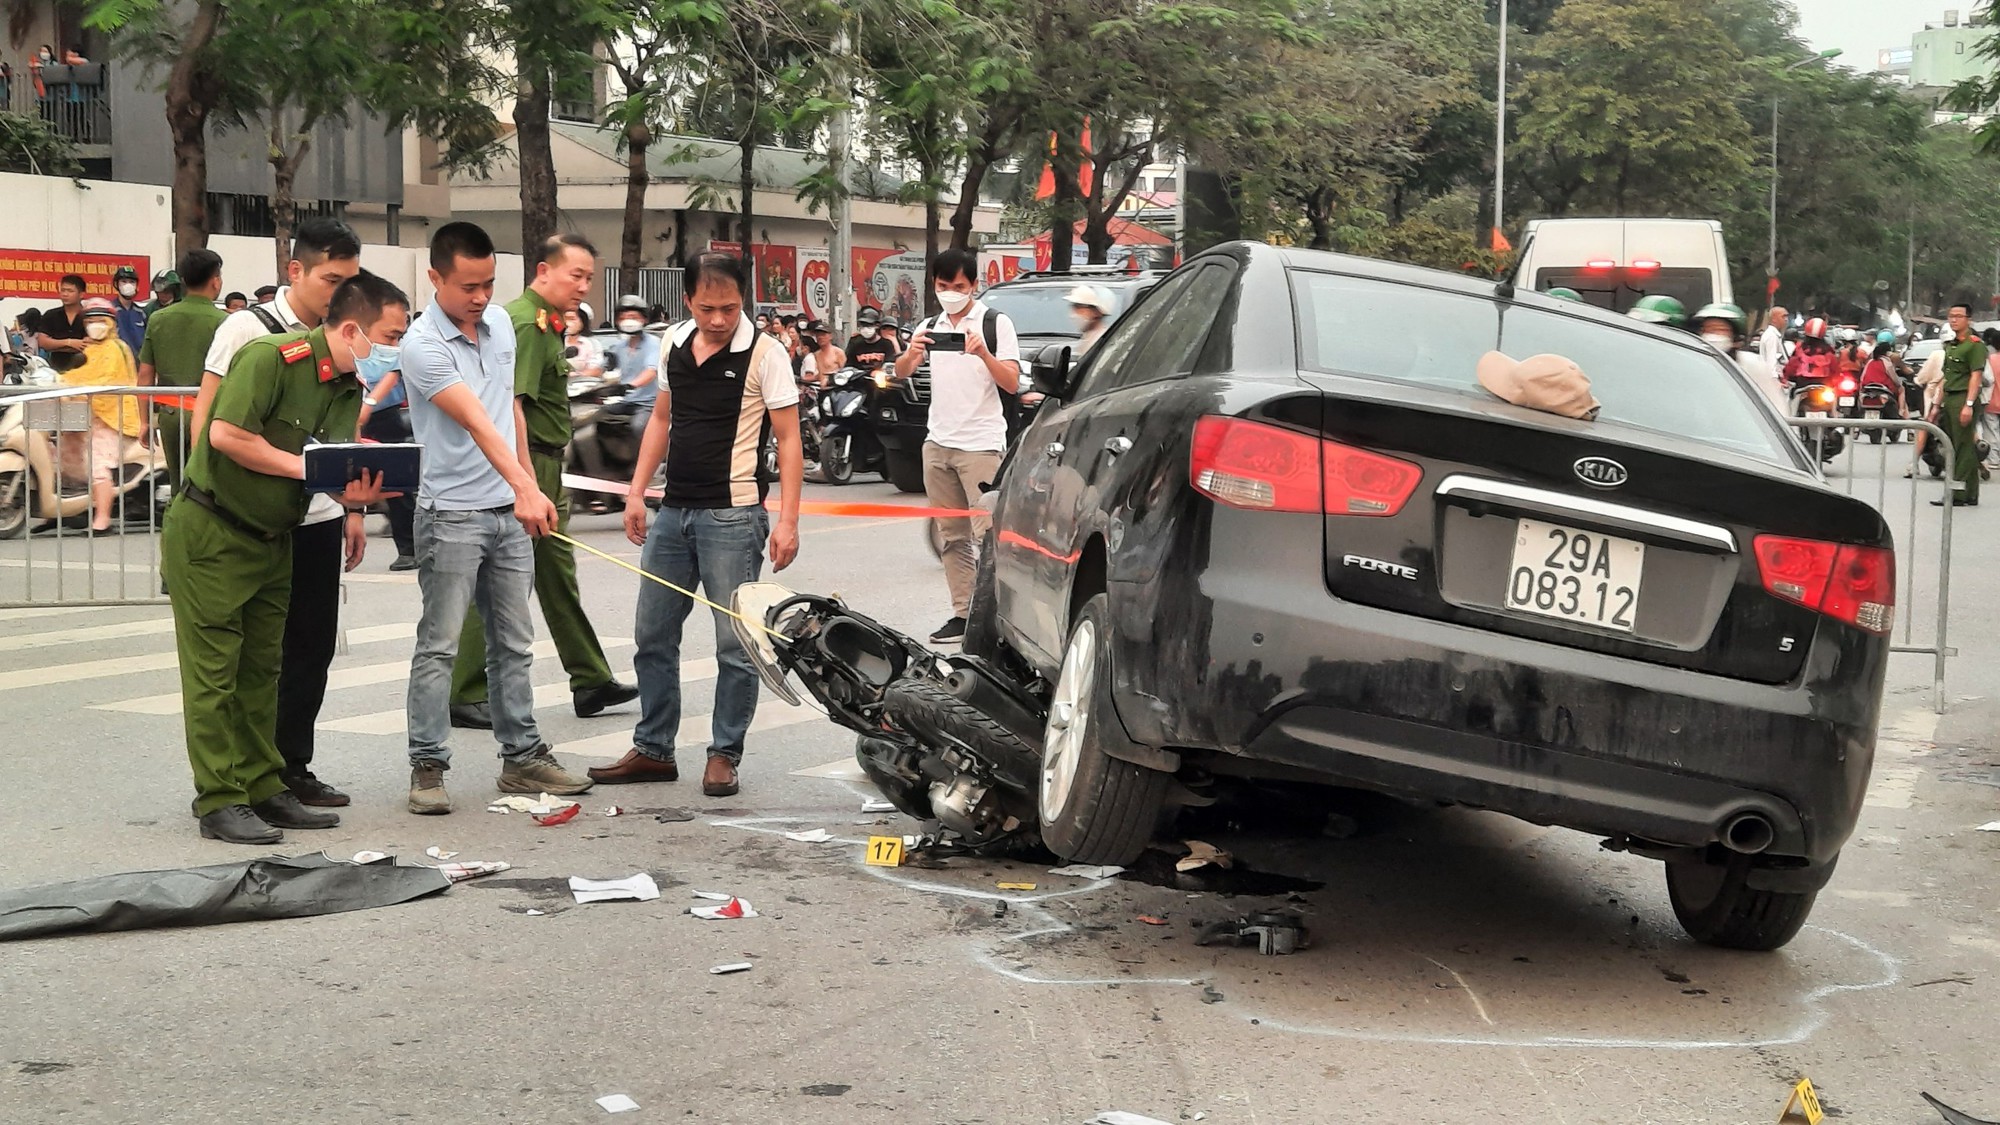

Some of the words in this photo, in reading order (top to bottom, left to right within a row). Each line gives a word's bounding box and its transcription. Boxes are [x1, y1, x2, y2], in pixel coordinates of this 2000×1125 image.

[1583, 461, 1618, 482] KIA
[1544, 528, 1611, 579] 29A
[1343, 554, 1419, 581] FORTE
[1511, 566, 1634, 628] 083.12
[1778, 636, 1795, 652] S
[874, 841, 897, 861] 17
[1802, 1086, 1819, 1117] 16
